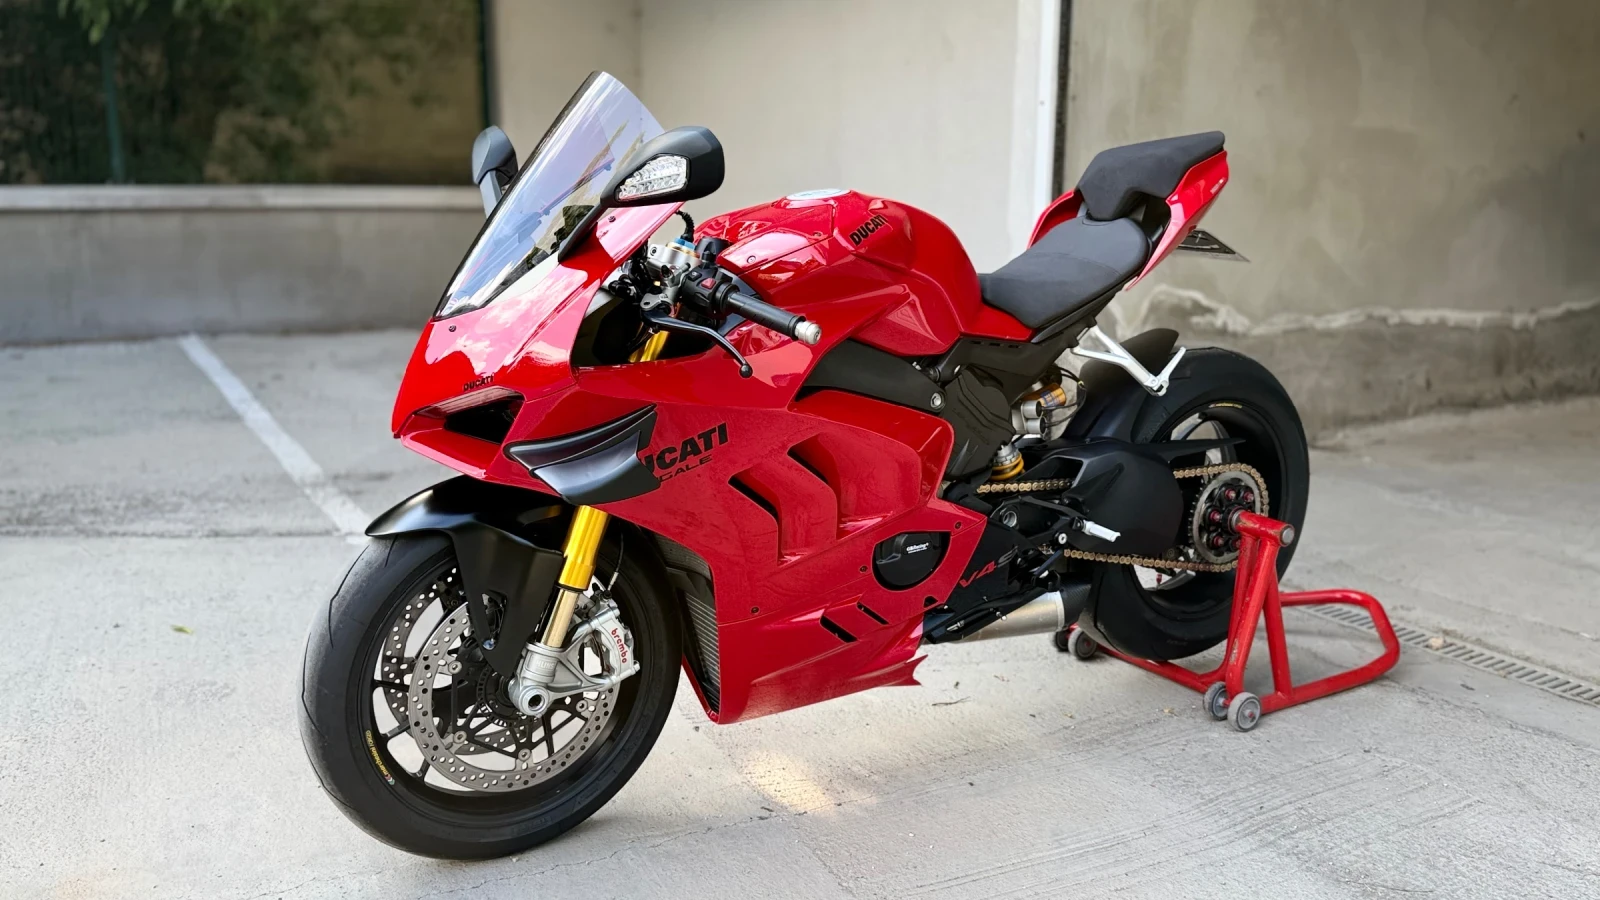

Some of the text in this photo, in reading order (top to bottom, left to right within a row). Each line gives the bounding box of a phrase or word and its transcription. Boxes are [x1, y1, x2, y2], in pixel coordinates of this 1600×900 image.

[849, 214, 889, 246] DUCATI
[463, 374, 494, 391] DUCATI
[611, 628, 628, 664] brembo
